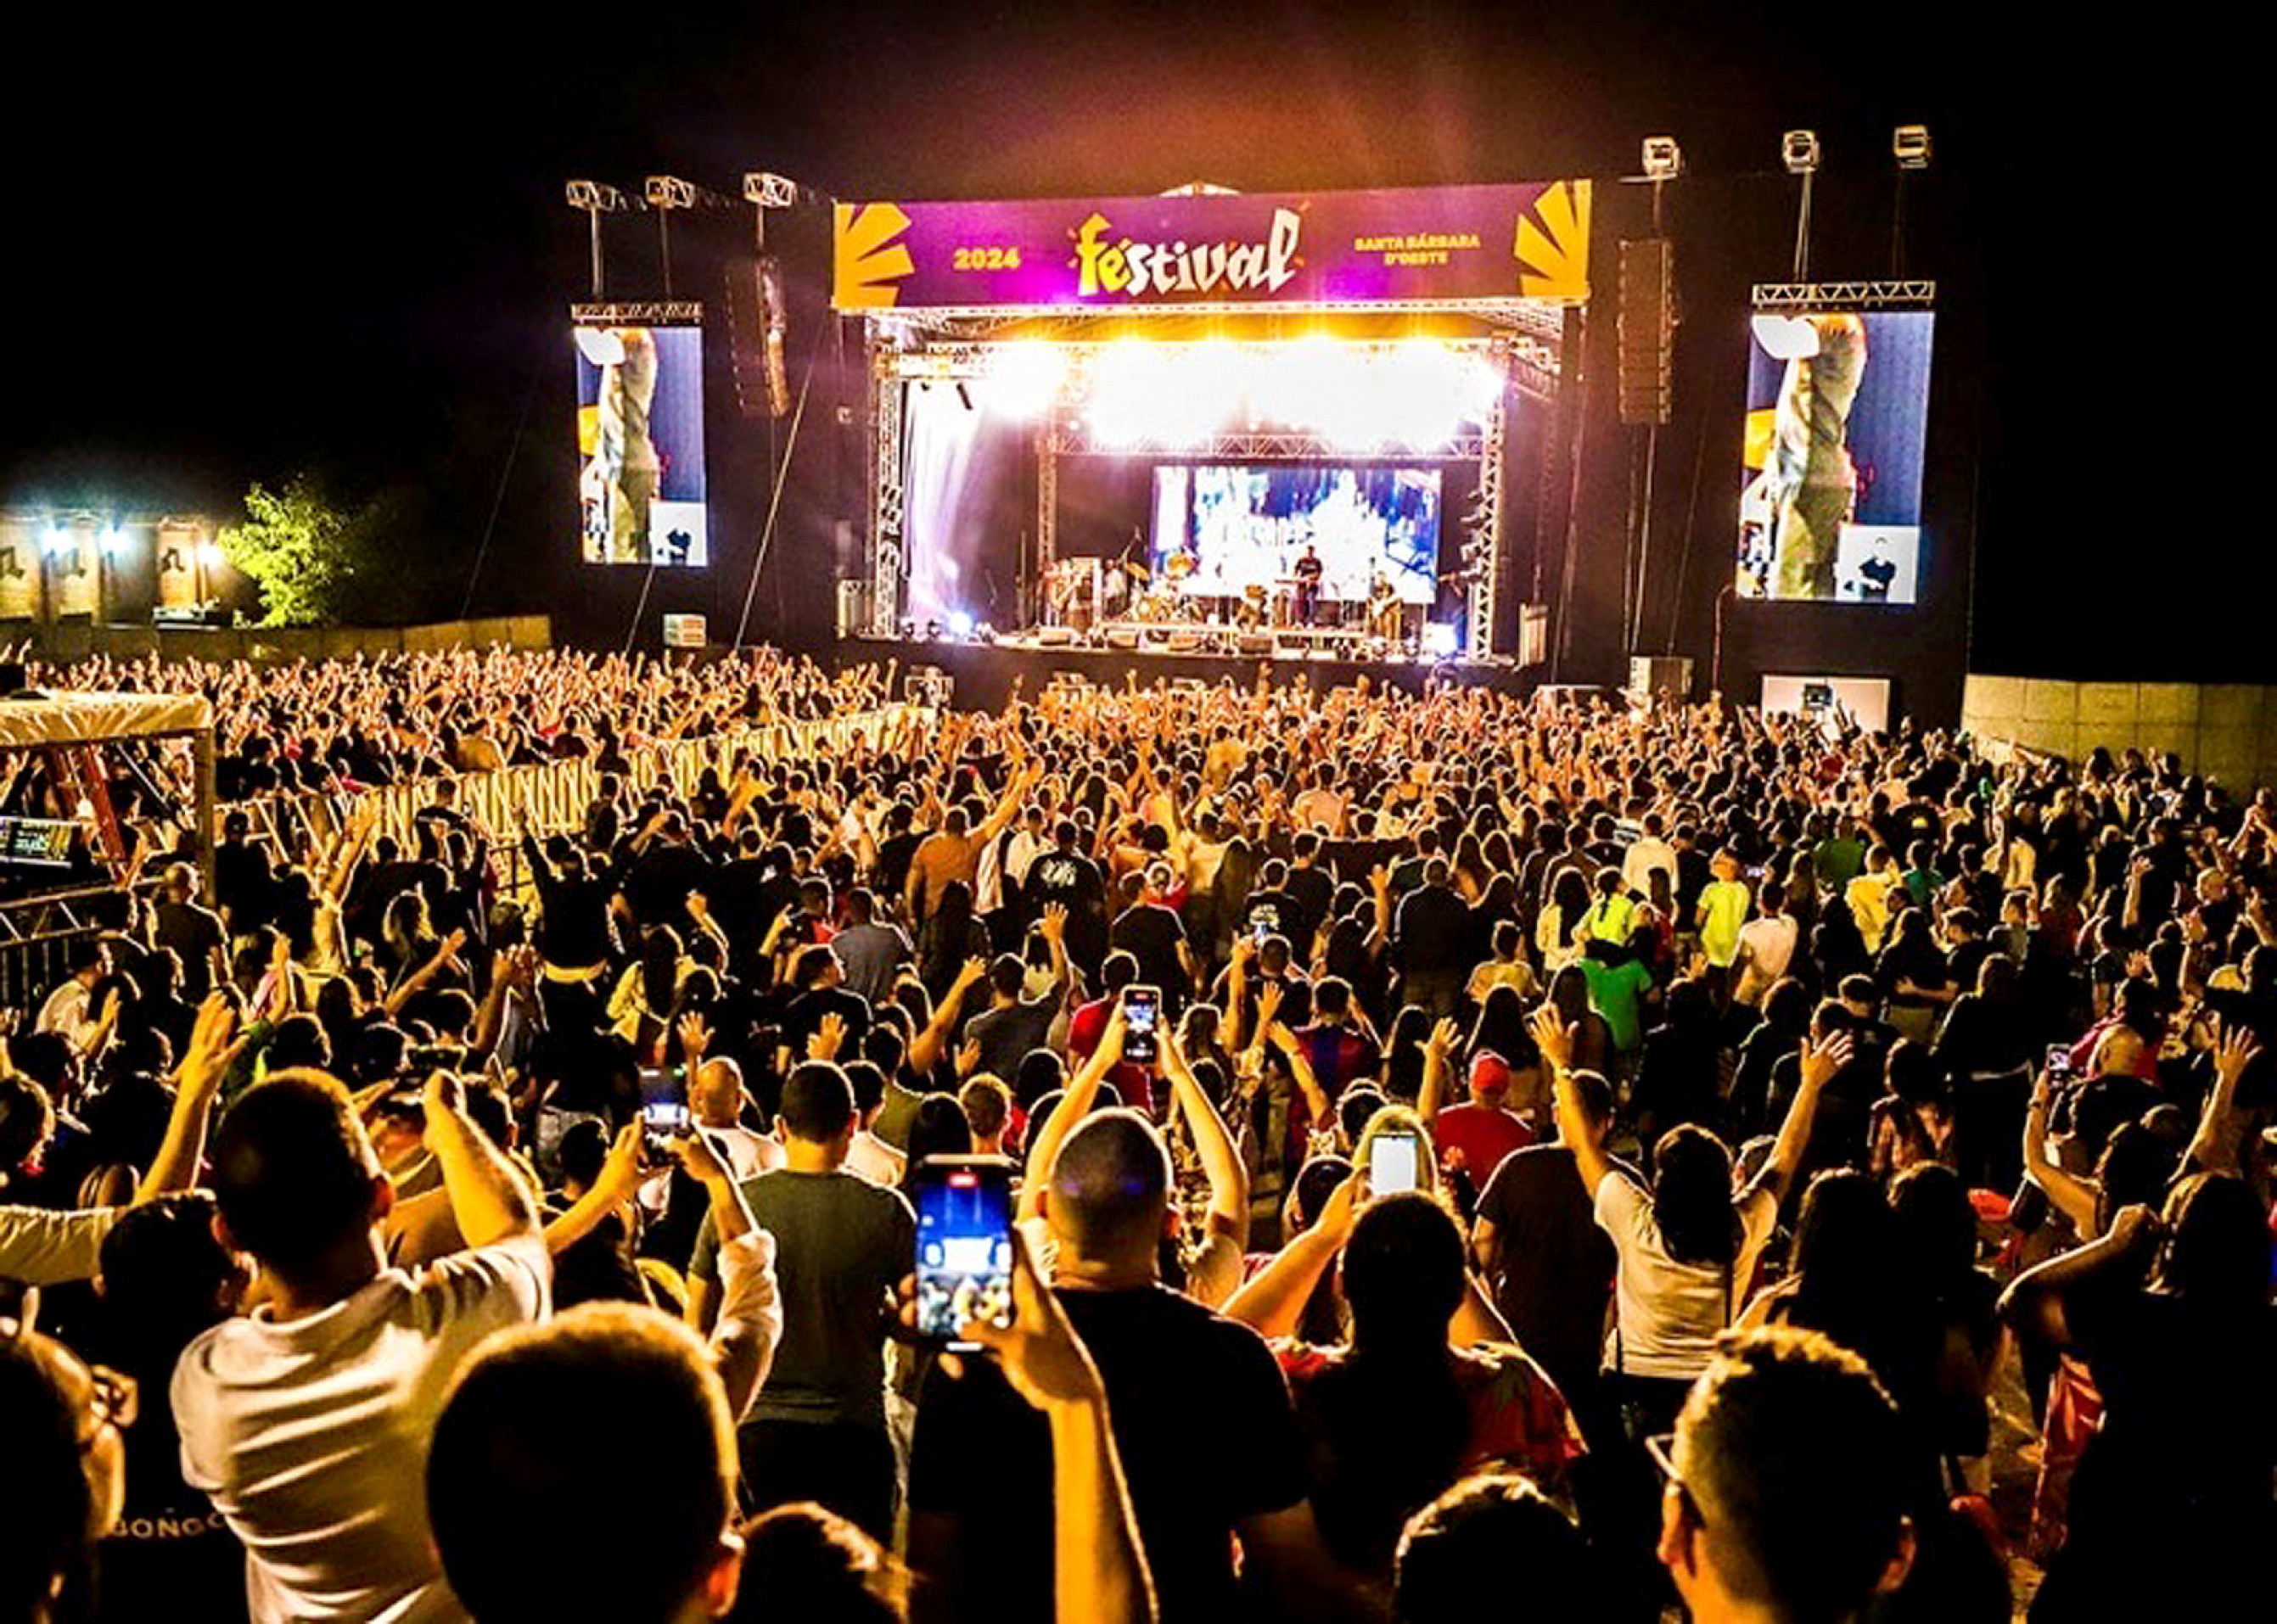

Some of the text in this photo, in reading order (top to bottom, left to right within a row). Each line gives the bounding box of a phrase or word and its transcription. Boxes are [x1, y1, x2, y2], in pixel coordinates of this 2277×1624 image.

[1354, 232, 1481, 251] SANTA BÁRBARA
[953, 247, 1021, 270] 2024
[1383, 250, 1448, 266] D'OESTE
